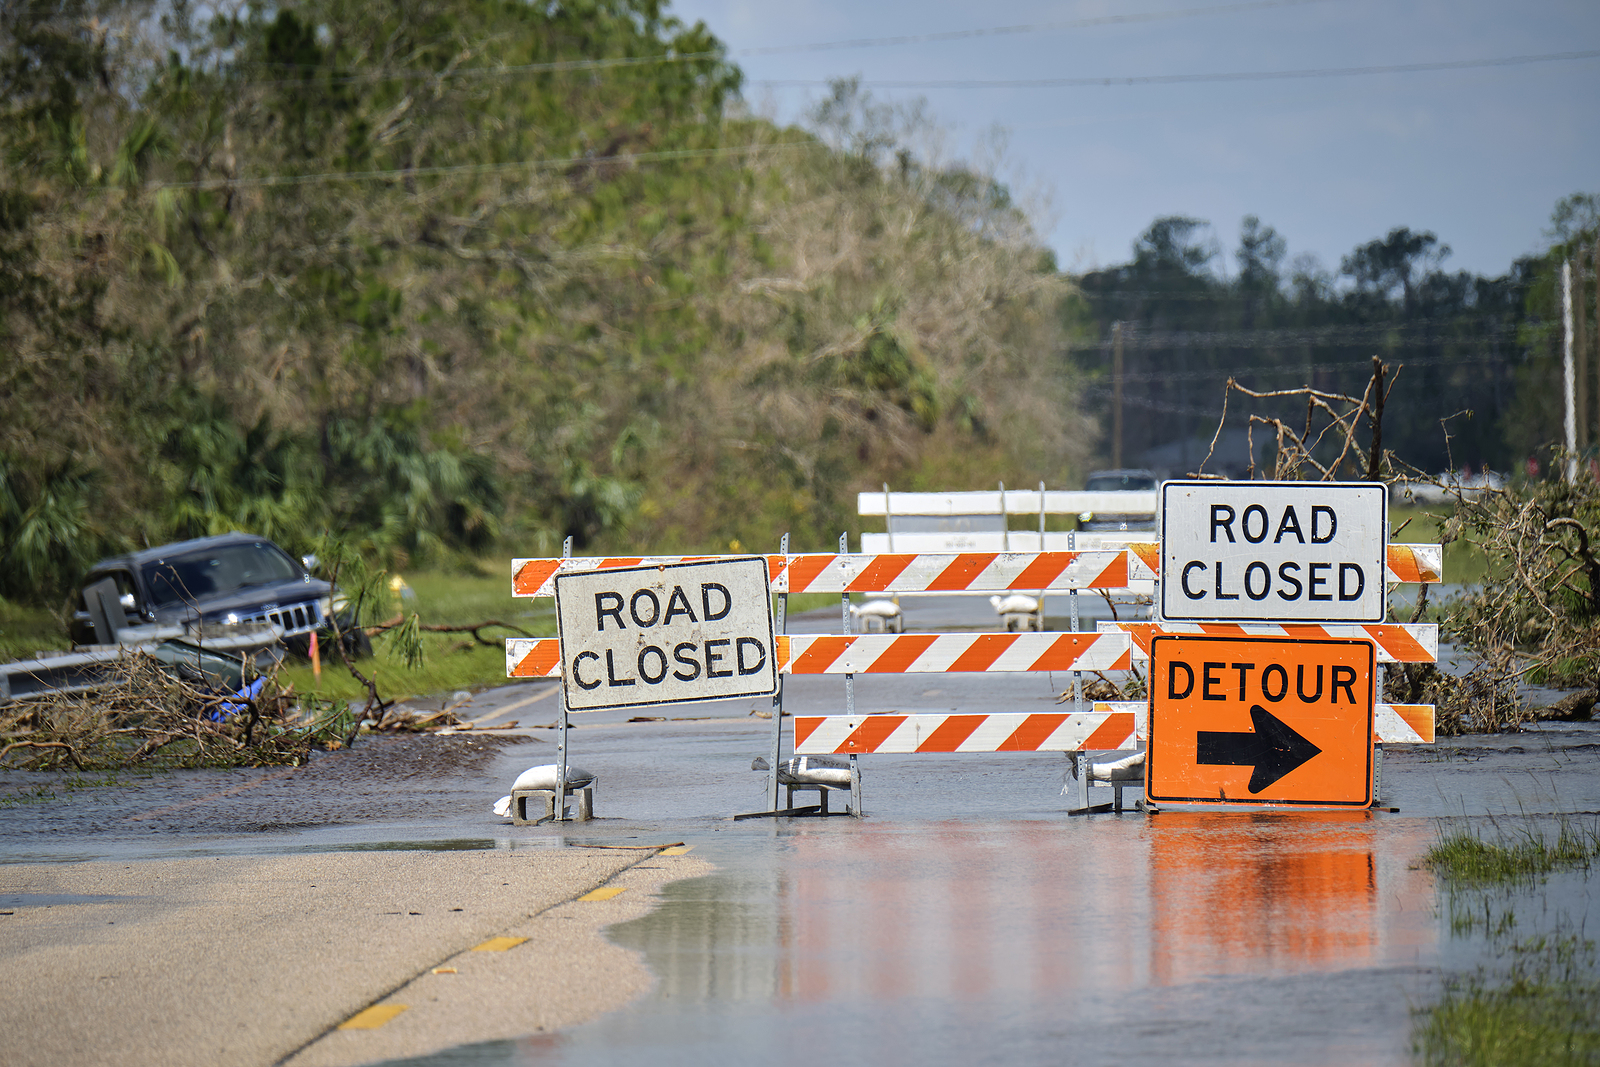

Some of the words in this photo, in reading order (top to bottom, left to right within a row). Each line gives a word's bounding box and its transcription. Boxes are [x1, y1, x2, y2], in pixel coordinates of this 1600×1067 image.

[1210, 504, 1337, 544] ROAD
[1181, 560, 1365, 601] CLOSED
[594, 582, 732, 631] ROAD
[572, 637, 767, 690] CLOSED
[1168, 660, 1357, 705] DETOUR
